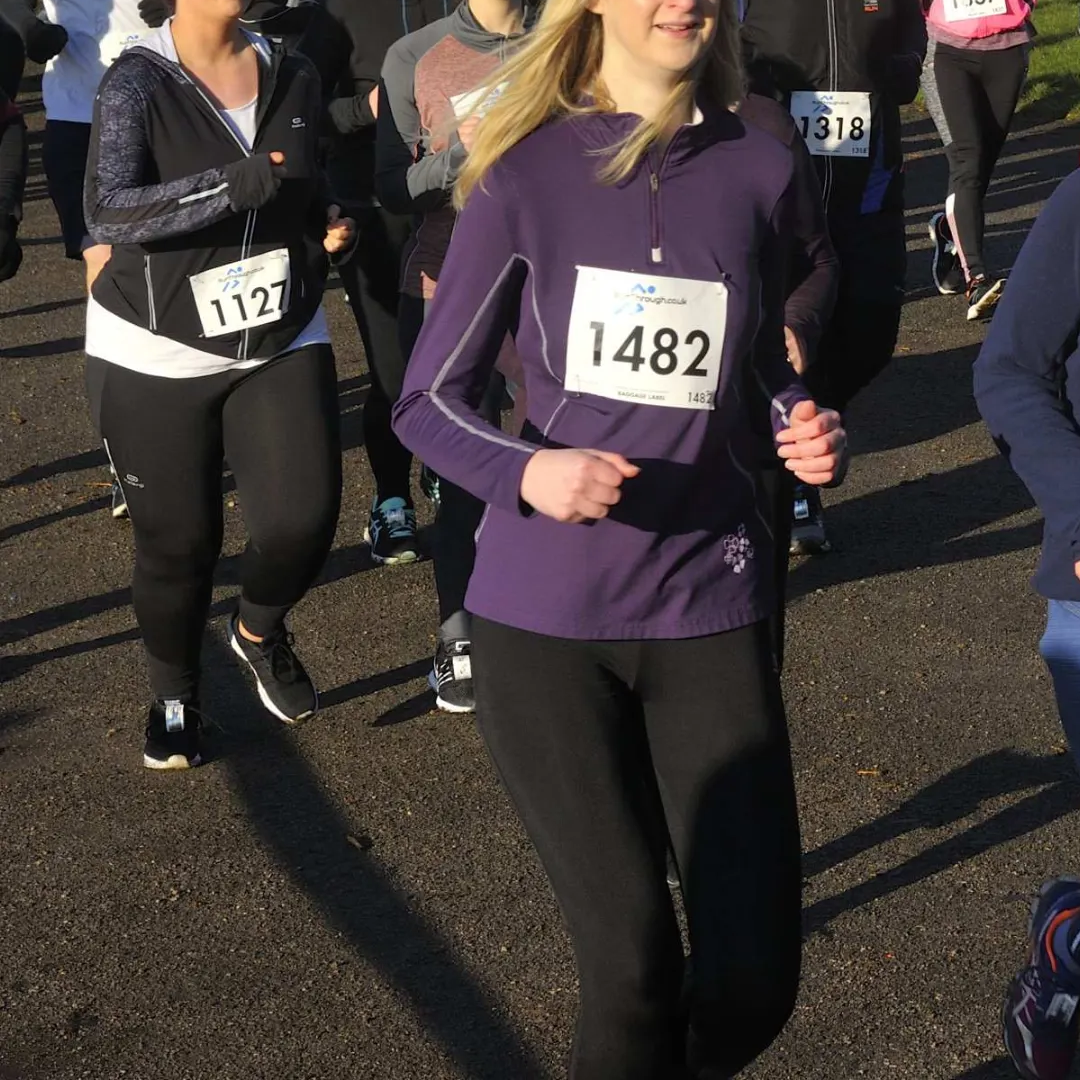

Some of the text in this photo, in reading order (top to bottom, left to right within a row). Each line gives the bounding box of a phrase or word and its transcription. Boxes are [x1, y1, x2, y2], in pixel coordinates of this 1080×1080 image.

[800, 116, 865, 141] 1318
[210, 279, 287, 327] 1127
[589, 321, 711, 377] 1482
